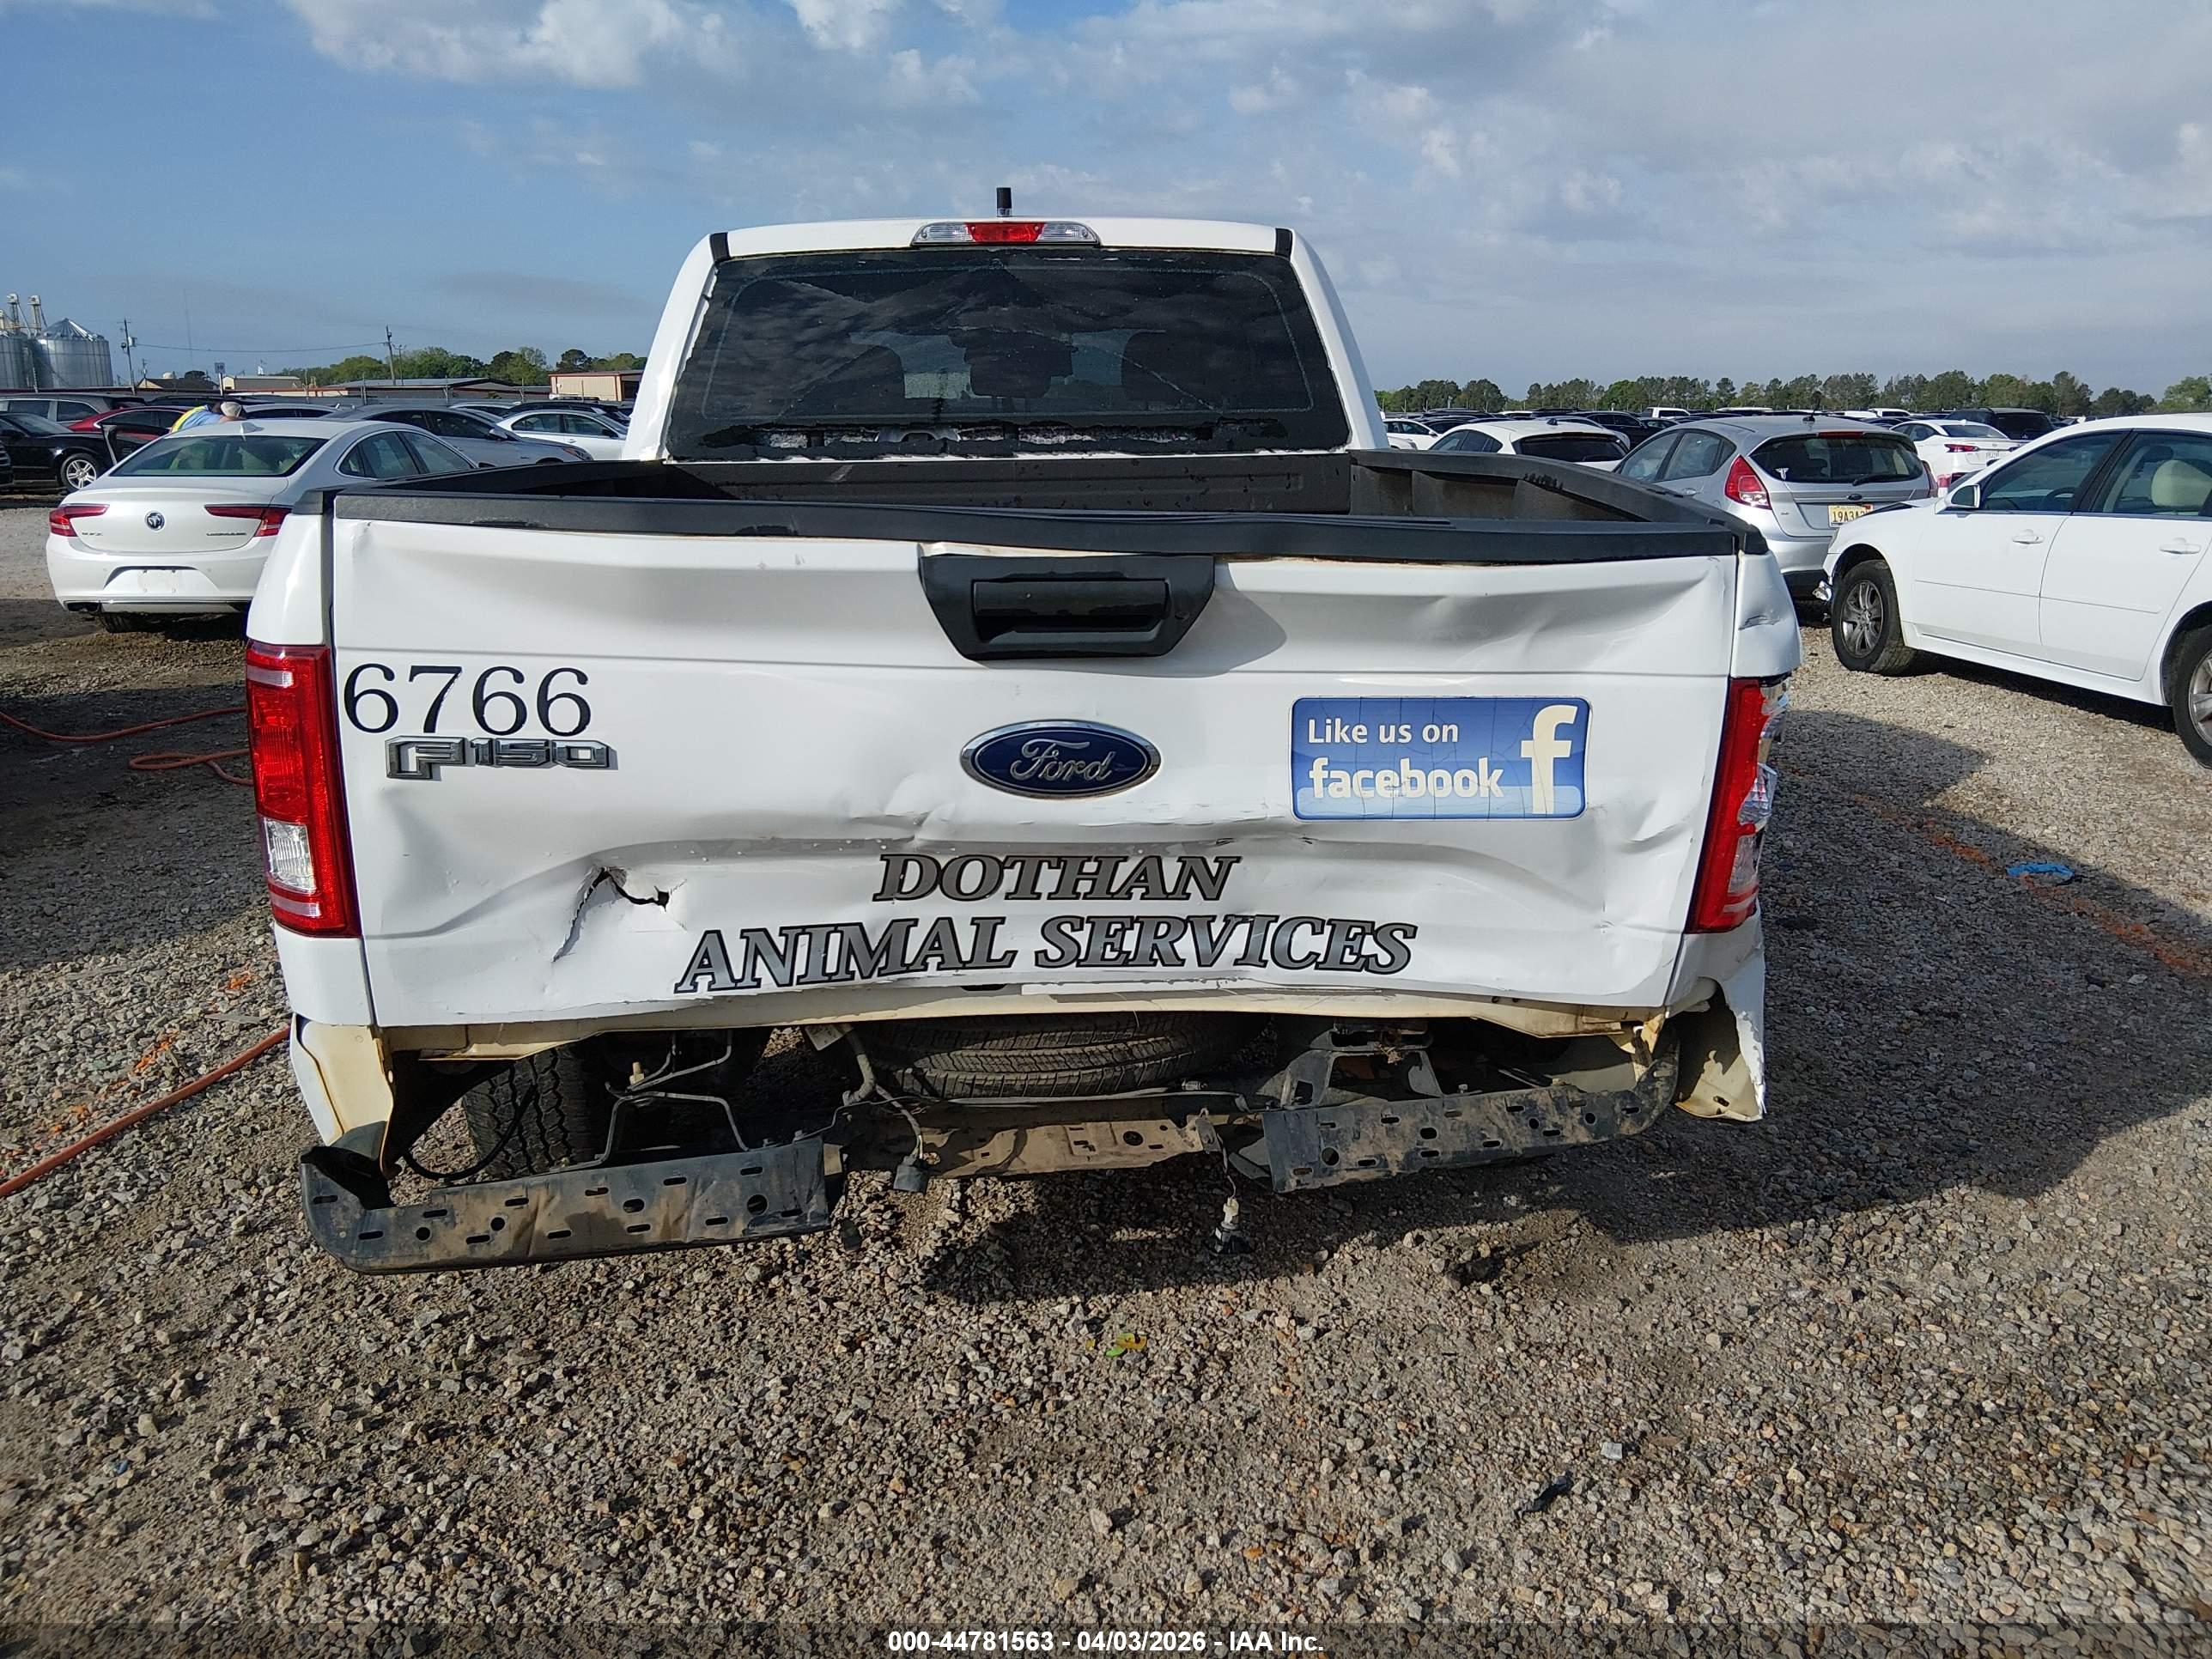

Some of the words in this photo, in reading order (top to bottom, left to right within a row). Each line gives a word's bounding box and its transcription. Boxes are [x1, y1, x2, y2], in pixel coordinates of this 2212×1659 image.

[343, 663, 592, 736] 6766
[1307, 718, 1368, 744] Like
[1378, 724, 1413, 744] us
[1422, 724, 1459, 744] on
[1010, 738, 1115, 781] Ford
[1309, 757, 1504, 799] facebook
[872, 854, 1243, 902] DOTHAN
[674, 916, 1018, 994] ANIMAL
[1035, 915, 1418, 975] SERVICES
